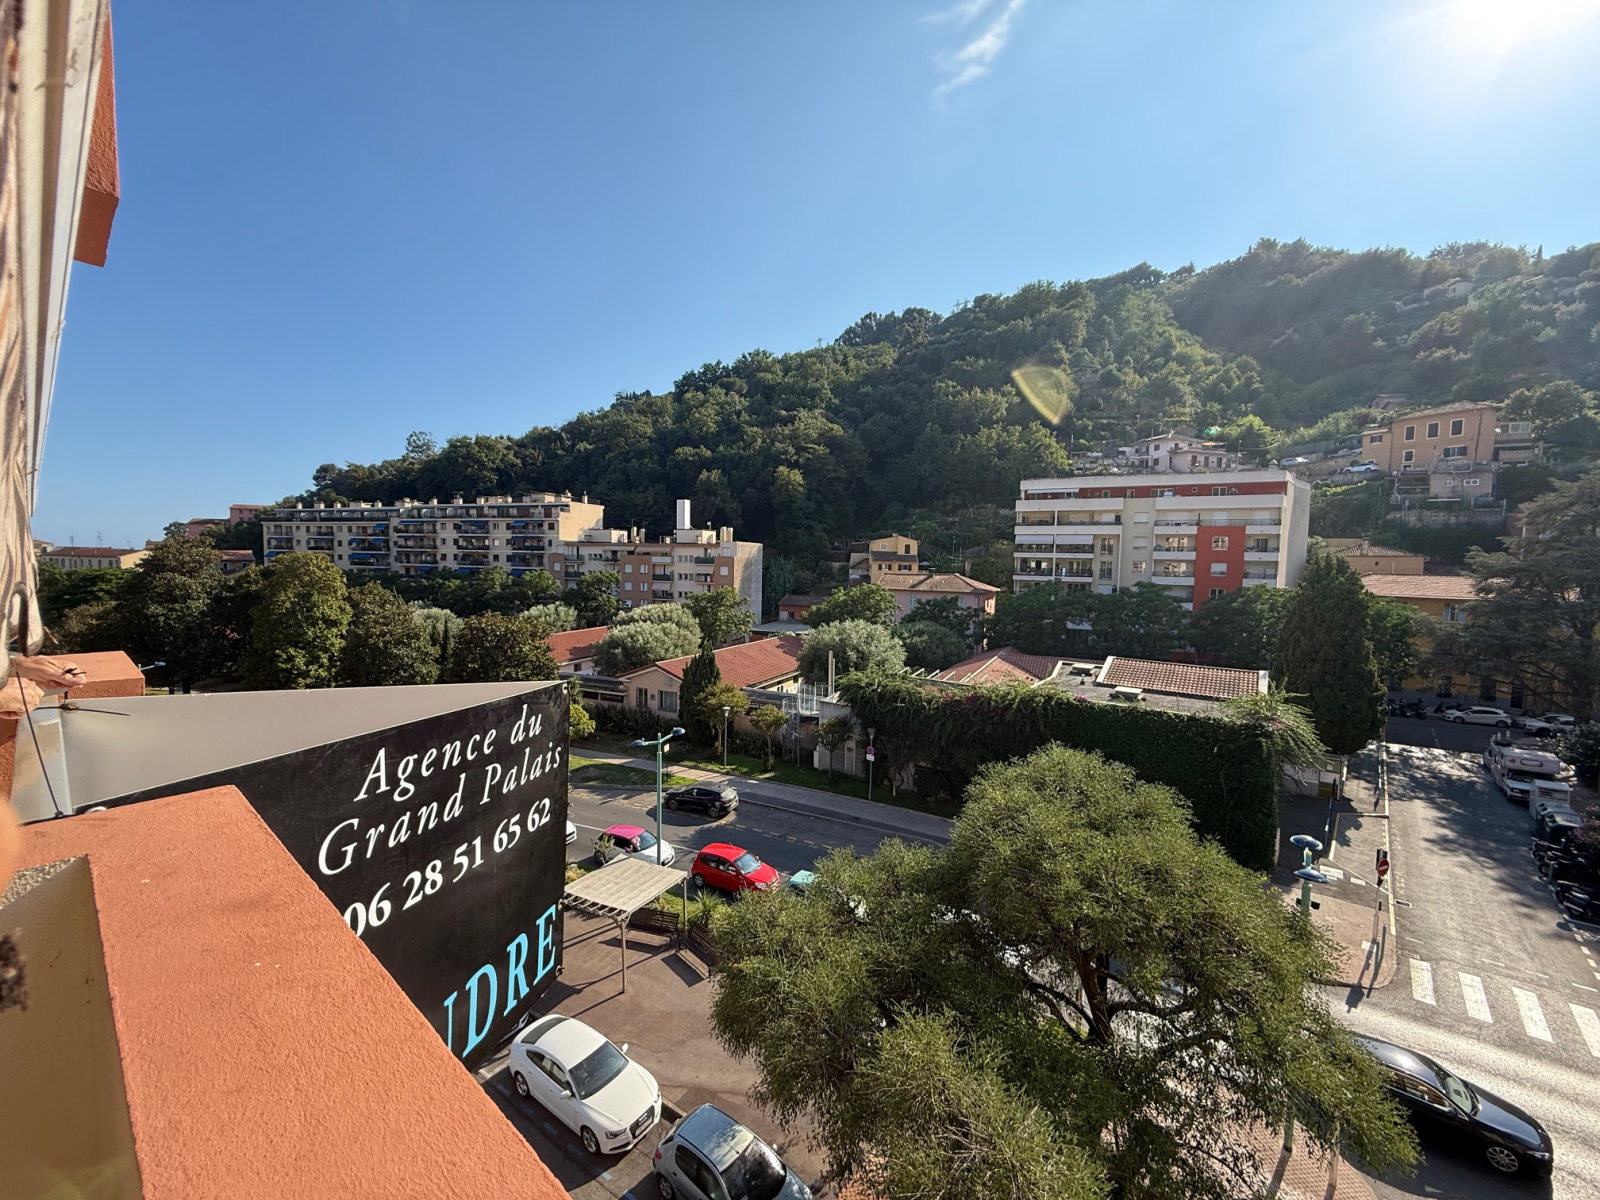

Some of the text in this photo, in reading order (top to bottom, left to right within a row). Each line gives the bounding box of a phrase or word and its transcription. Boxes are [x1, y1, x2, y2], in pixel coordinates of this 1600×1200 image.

[318, 742, 562, 875] Grand Palais
[353, 704, 542, 801] Agence du
[343, 798, 551, 938] 06 28 51 65 62
